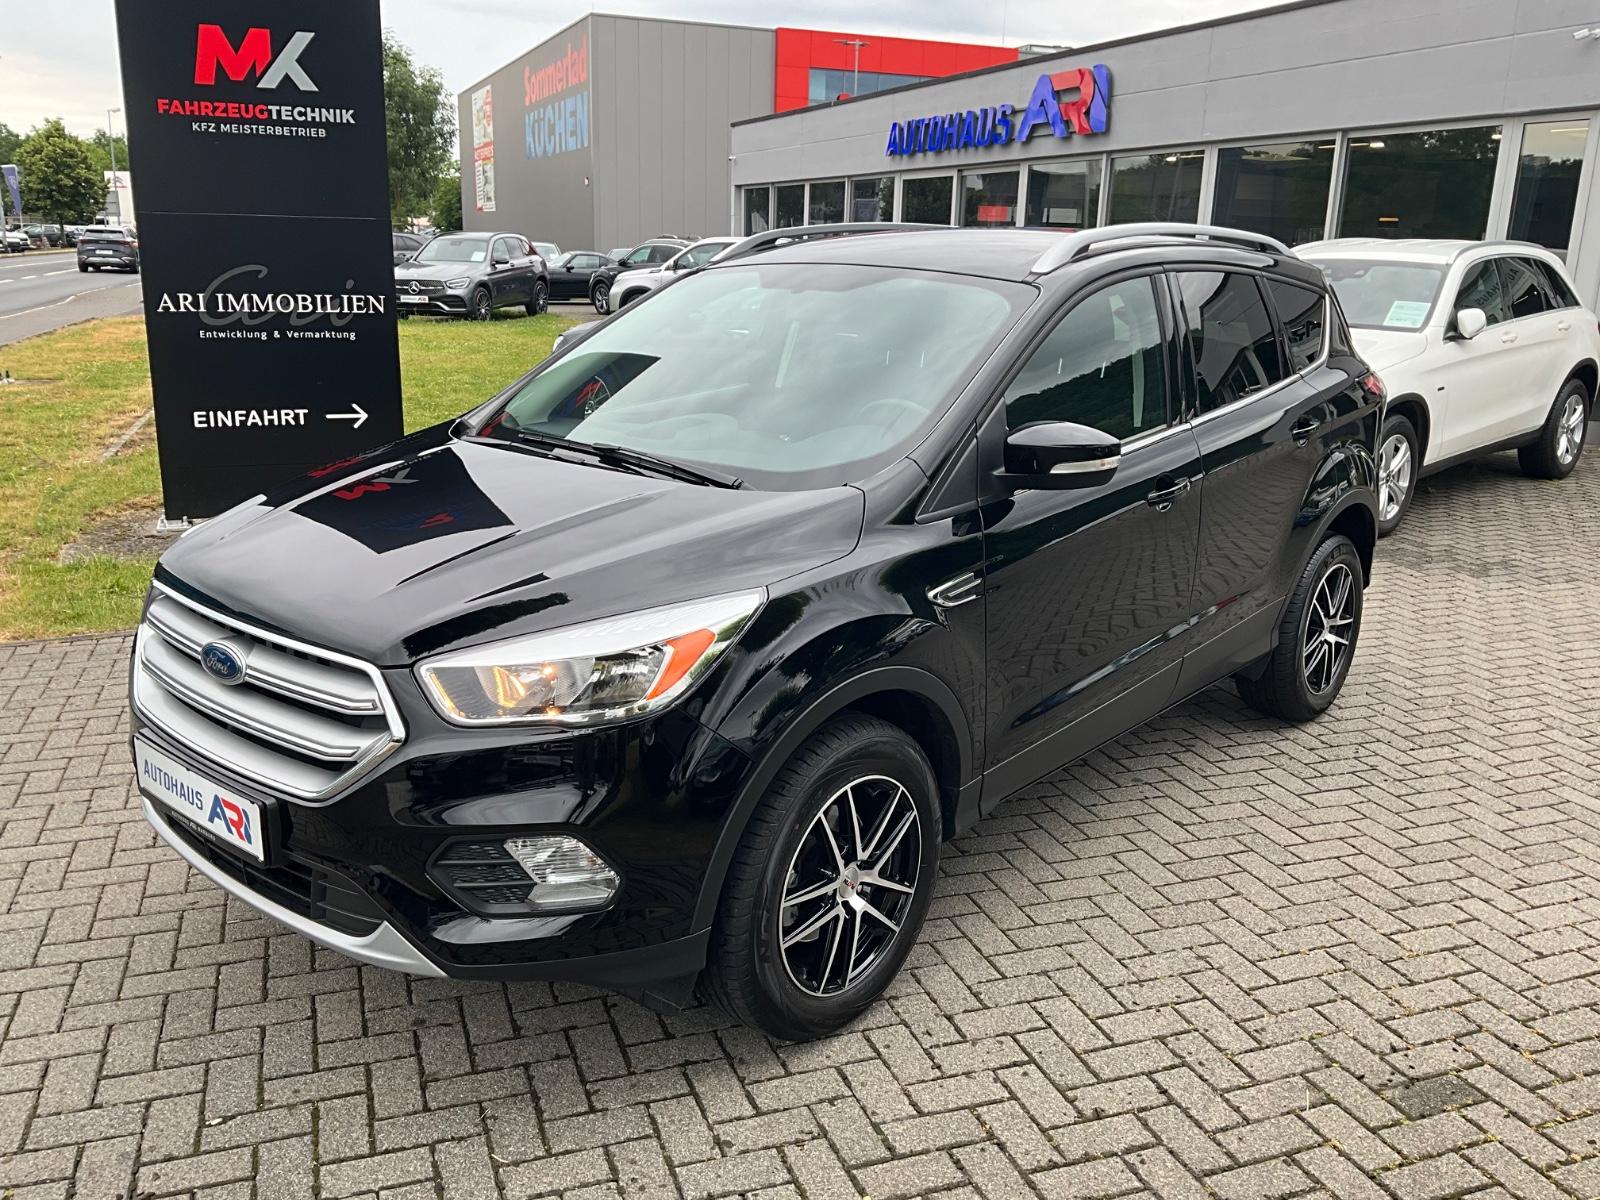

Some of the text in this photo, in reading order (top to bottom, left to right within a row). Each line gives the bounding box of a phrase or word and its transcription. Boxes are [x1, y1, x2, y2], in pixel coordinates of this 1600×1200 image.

[194, 23, 319, 92] MK
[523, 34, 588, 106] Sommerlad
[156, 98, 356, 124] FAHRZEUGTECHNIK
[191, 121, 327, 138] KFZ MEISTERBETRIEB
[524, 91, 590, 160] KÜCHEN
[885, 63, 1113, 157] AUTOHAUS ARI
[156, 293, 207, 313] ARI
[216, 293, 386, 314] IMMOBILIEN
[199, 330, 357, 341] Entwicklung & Vermarktung
[193, 409, 309, 428] EINFAHRT
[143, 759, 203, 811] AUTOHAUS
[207, 793, 253, 846] ARI
